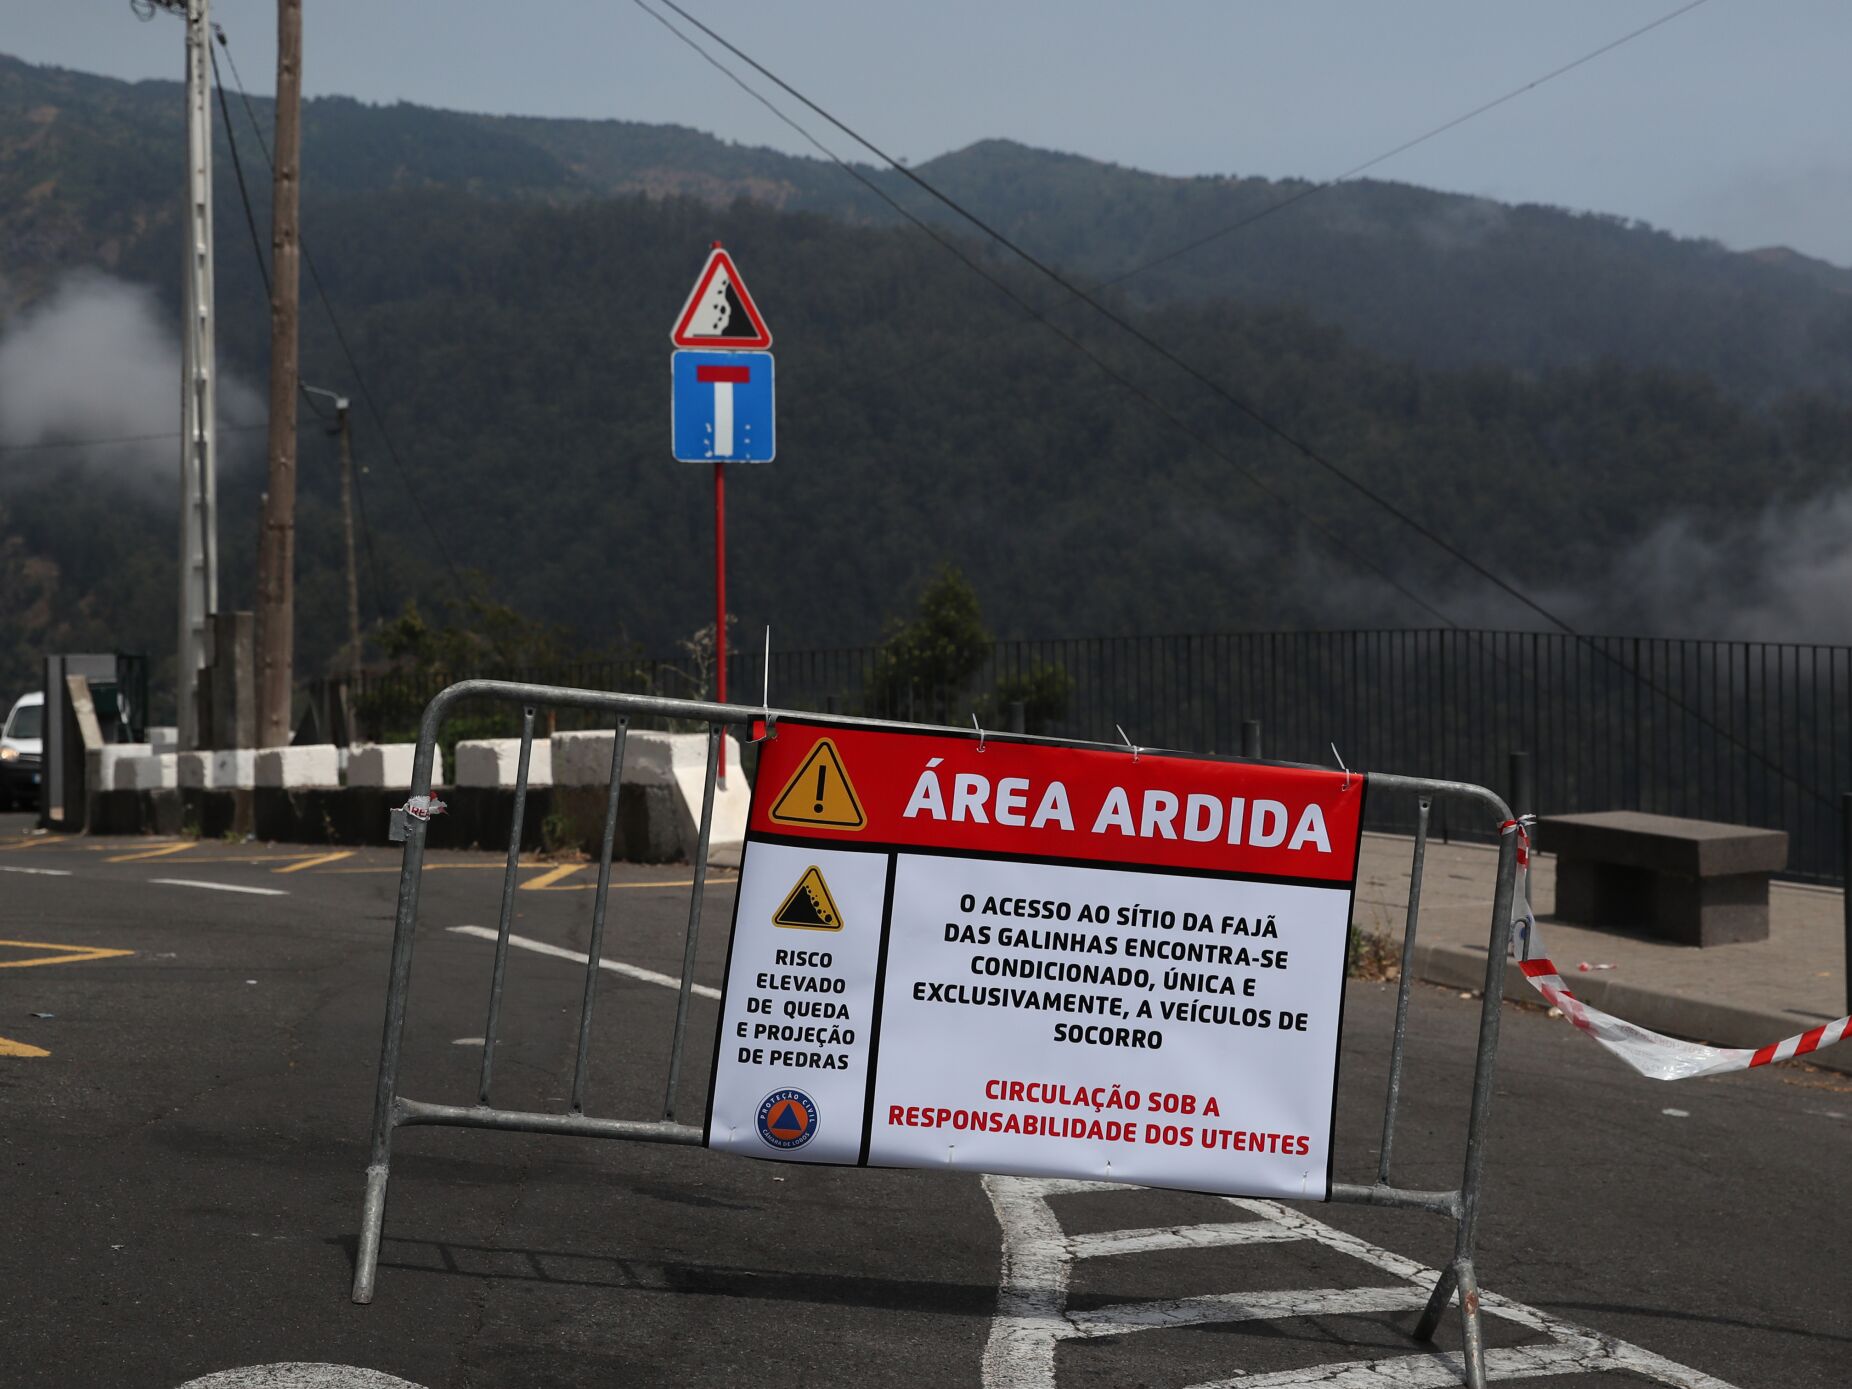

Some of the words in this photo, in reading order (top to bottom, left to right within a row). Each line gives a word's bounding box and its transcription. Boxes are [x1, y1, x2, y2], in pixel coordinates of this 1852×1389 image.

[903, 758, 1074, 830] ÁREA
[1092, 787, 1331, 852] ARDIDA
[961, 894, 975, 912] O
[982, 896, 1071, 920] ACESSO
[1077, 904, 1109, 923] AO
[1117, 904, 1175, 929] SÍTIO
[1183, 913, 1213, 932] DA
[1221, 915, 1277, 938] FAJÃ
[776, 950, 832, 968] RISCO
[945, 923, 991, 944] DAS
[998, 928, 1117, 955] GALINHAS
[1125, 938, 1288, 971] ENCONTRA-SE
[757, 973, 845, 993] ELEVADO
[971, 956, 1155, 991] CONDICIONADO,
[1164, 968, 1235, 995] ÚNICA
[1243, 978, 1255, 996] E
[747, 998, 772, 1014] DE
[784, 1001, 849, 1019] QUEDA
[913, 982, 1129, 1019] EXCLUSIVAMENTE,
[1136, 1000, 1152, 1018] A
[1160, 999, 1271, 1028] VEÍCULOS
[1279, 1012, 1308, 1031] DE
[737, 1022, 747, 1037] E
[754, 1024, 854, 1047] PROJEÇÃO
[1054, 1023, 1162, 1049] SOCORRO
[738, 1048, 763, 1064] DE
[770, 1050, 848, 1069] PEDRAS
[760, 1092, 799, 1119] PROTEÇÃO
[802, 1100, 815, 1123] CIVIL
[986, 1080, 1140, 1112] CIRCULAÇÃO
[1149, 1092, 1196, 1115] SOB
[1204, 1097, 1219, 1117] A
[792, 1132, 810, 1145] LOBOS
[889, 1105, 1136, 1143] RESPONSABILIDADE
[1145, 1123, 1193, 1147] DOS
[1202, 1129, 1309, 1155] UTENTES
